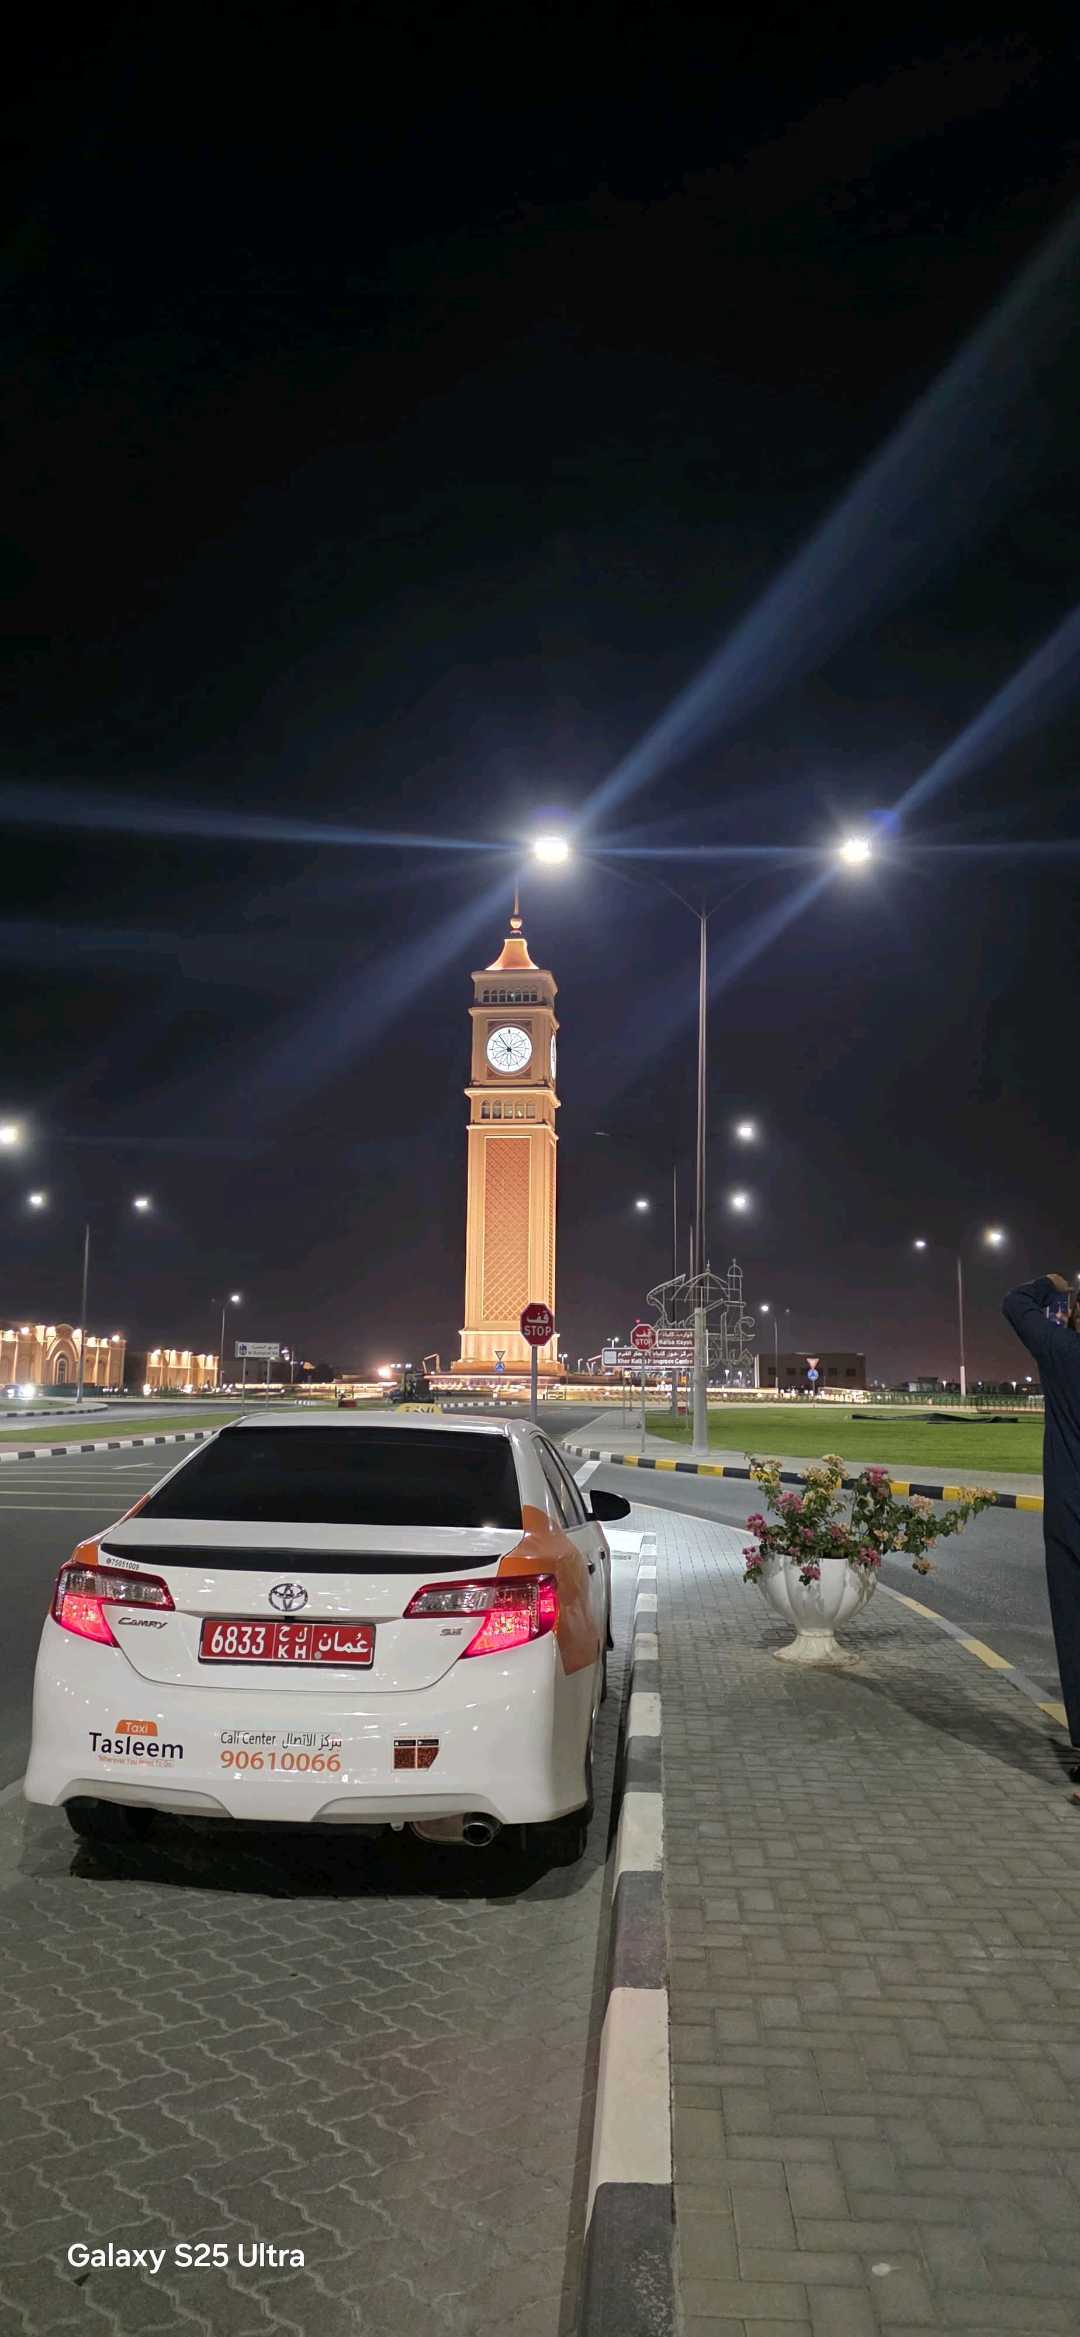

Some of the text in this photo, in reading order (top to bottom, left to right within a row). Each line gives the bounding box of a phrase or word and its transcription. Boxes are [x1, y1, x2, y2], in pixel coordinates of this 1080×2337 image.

[527, 1311, 549, 1324] قف
[524, 1325, 551, 1336] STOP
[636, 1329, 652, 1338] قف
[635, 1338, 652, 1346] STOP
[211, 1625, 266, 1655] 6833
[125, 1722, 149, 1734] Taxi
[220, 1731, 276, 1745] Call Center
[318, 1734, 342, 1751] مركز
[88, 1731, 184, 1760] Tasleem
[220, 1750, 342, 1772] 90610066
